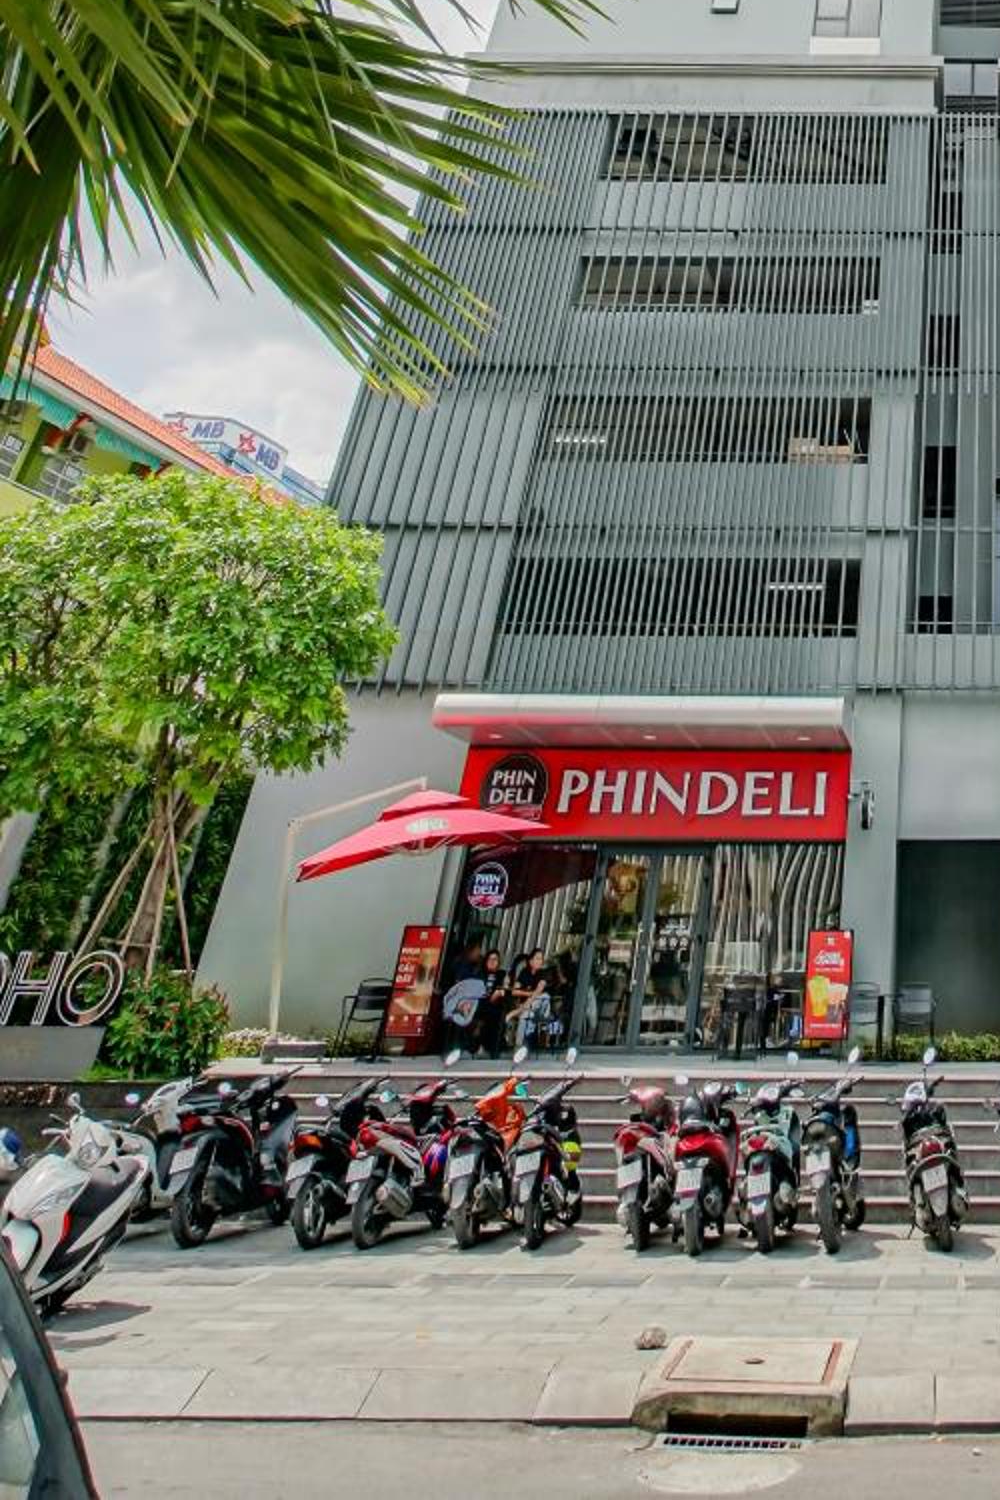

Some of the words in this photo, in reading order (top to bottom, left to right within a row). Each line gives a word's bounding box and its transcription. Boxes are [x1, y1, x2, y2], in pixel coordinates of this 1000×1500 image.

[191, 421, 225, 438] MB
[256, 443, 280, 471] MB
[491, 769, 537, 787] PHIN
[488, 787, 534, 805] DELI
[556, 769, 828, 817] PHINDELI
[475, 873, 501, 885] PHIN
[0, 950, 124, 1027] HO
